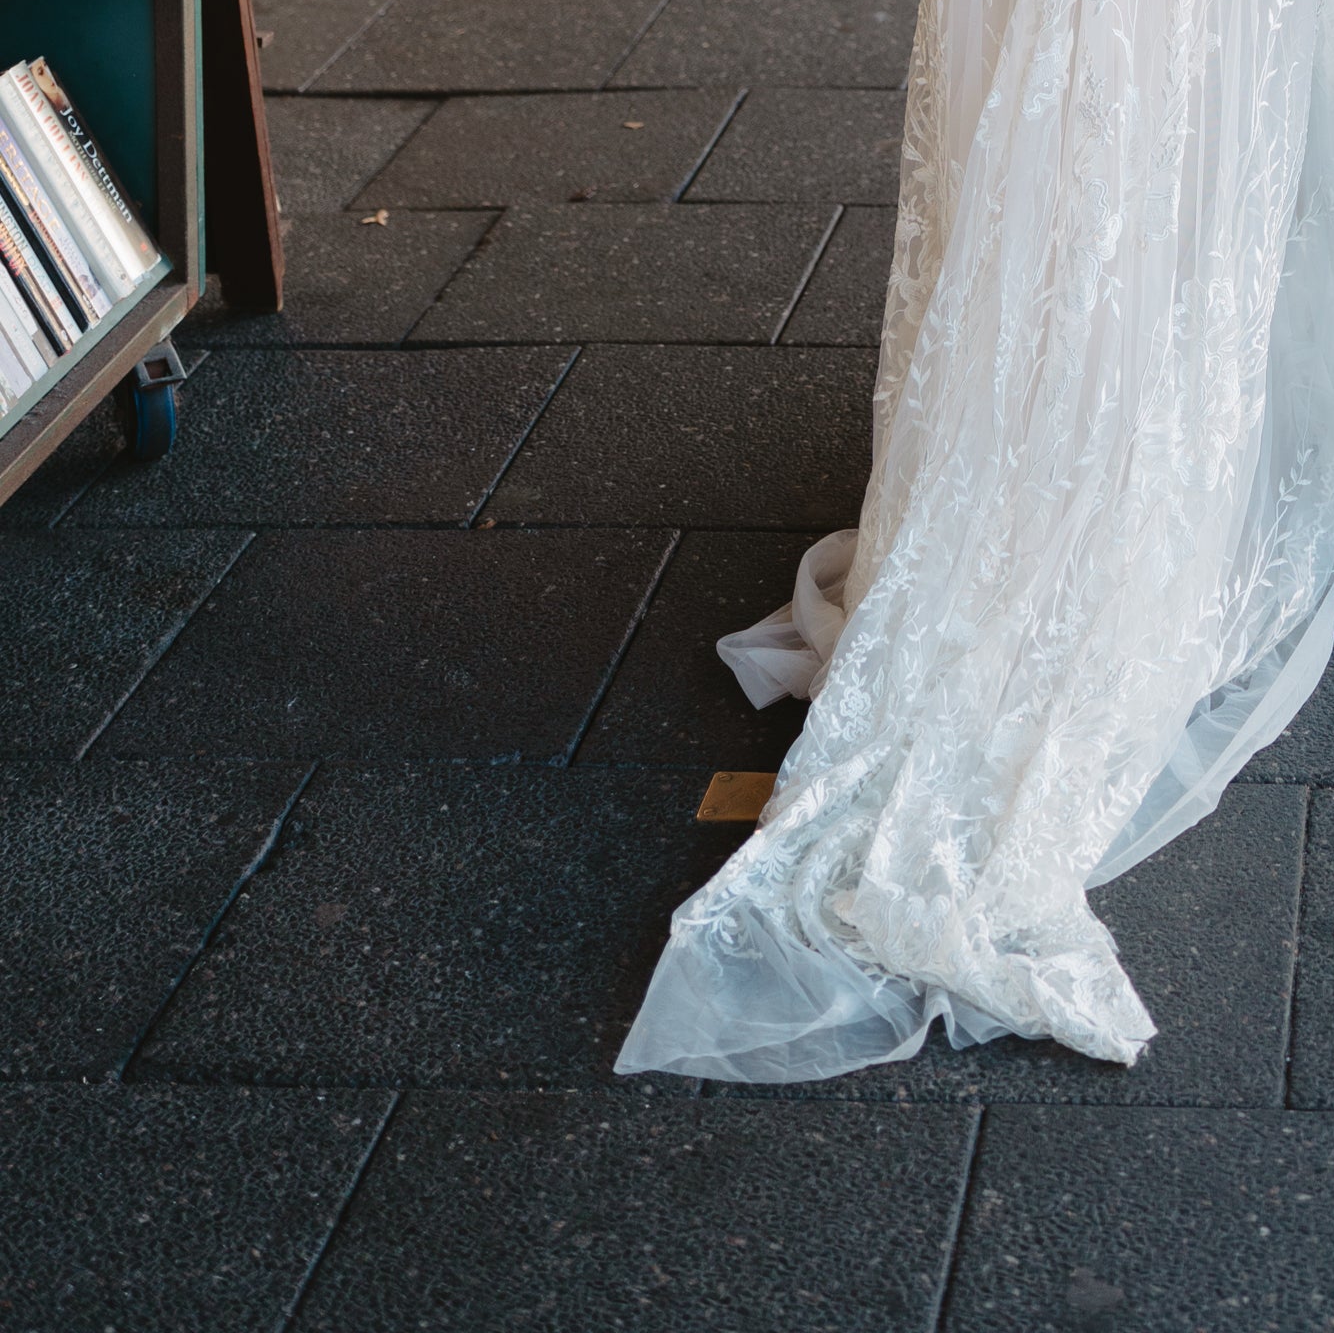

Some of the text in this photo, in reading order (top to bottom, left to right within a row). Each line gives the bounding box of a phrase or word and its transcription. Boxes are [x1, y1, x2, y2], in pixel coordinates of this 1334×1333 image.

[16, 73, 45, 113] JOAN
[60, 107, 133, 224] Joy Dettman
